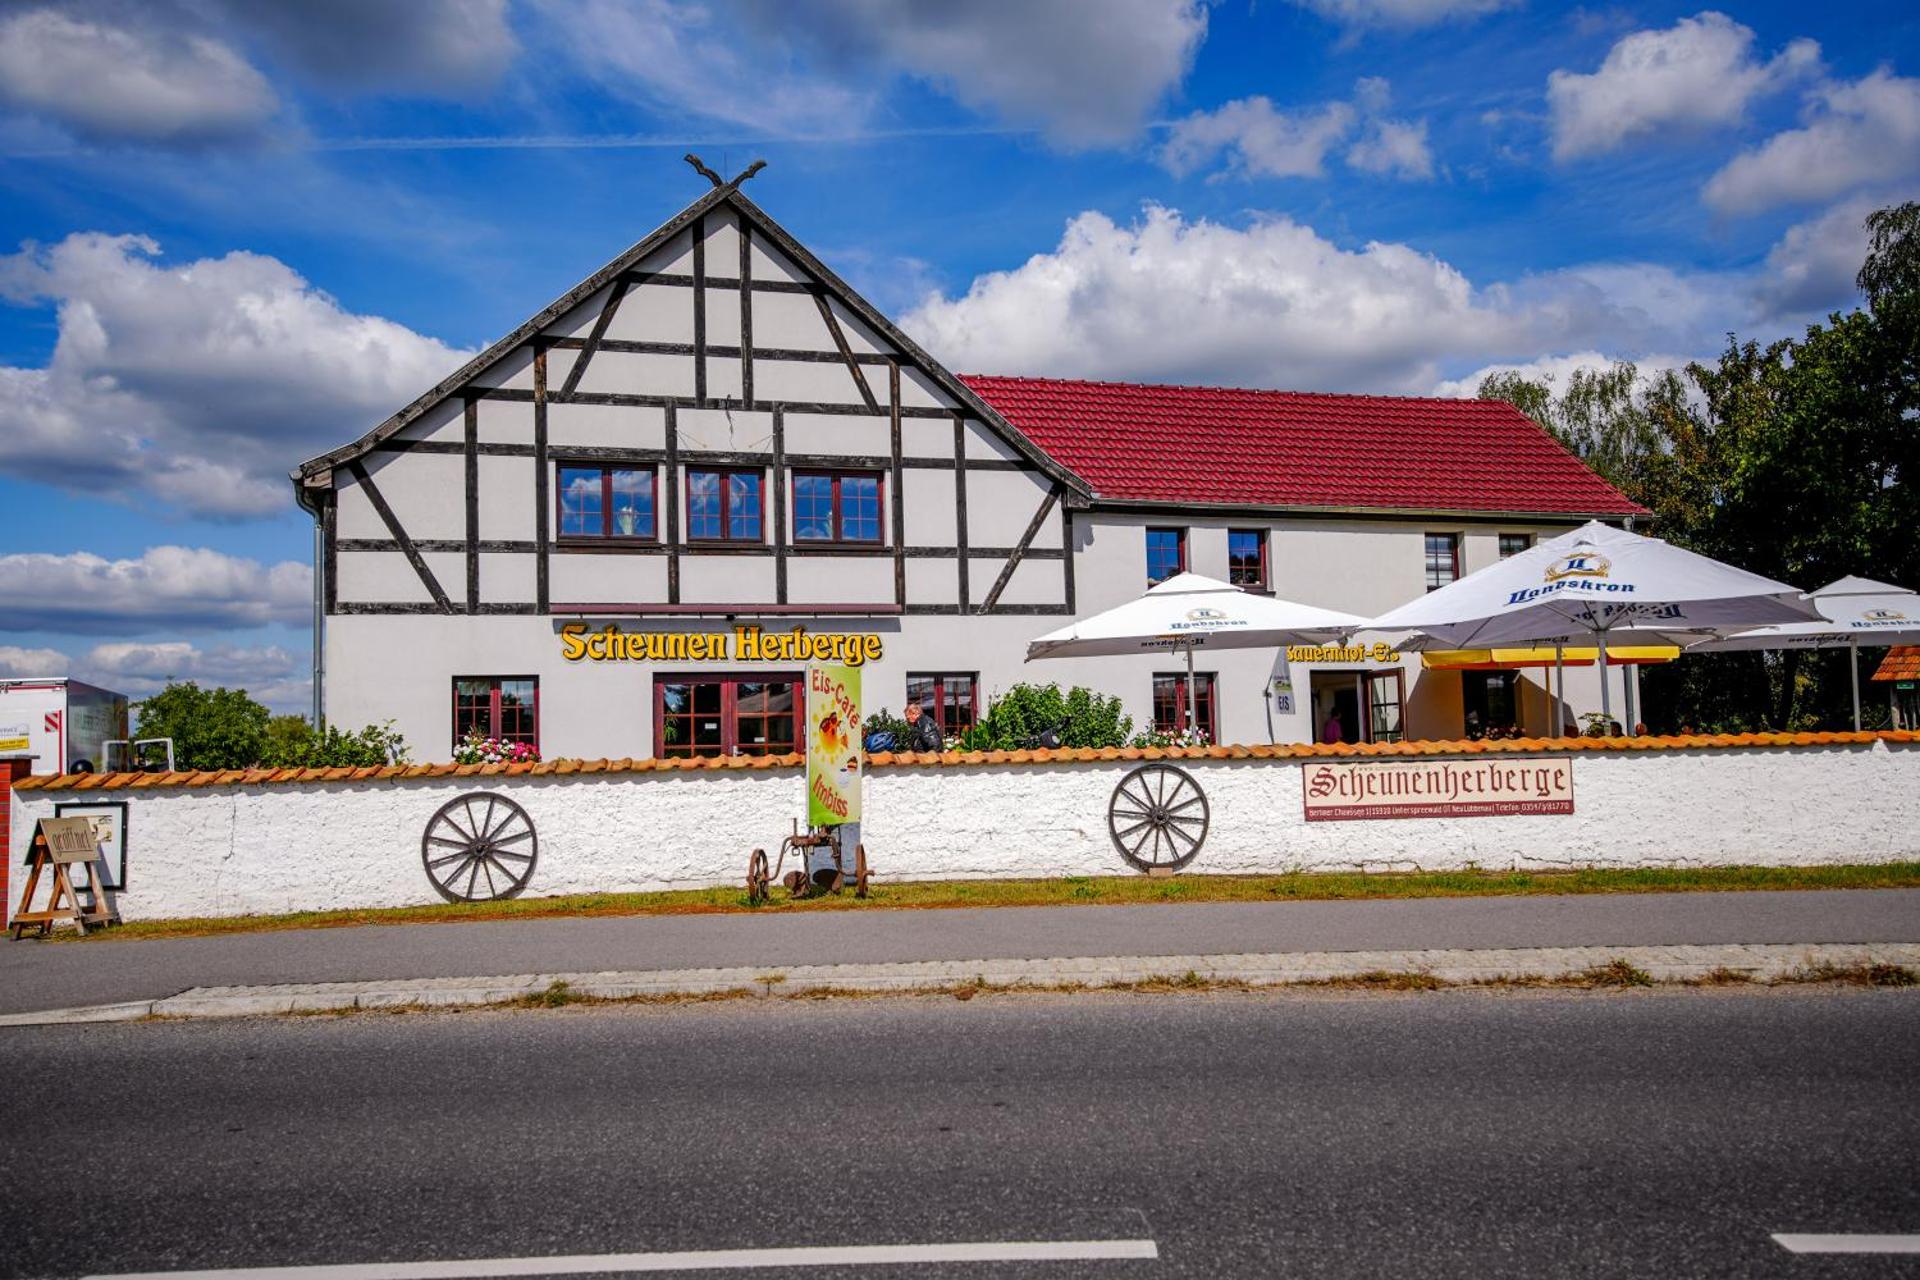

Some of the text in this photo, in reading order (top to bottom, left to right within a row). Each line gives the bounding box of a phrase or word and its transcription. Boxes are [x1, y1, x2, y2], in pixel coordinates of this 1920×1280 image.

[1850, 619, 1920, 627] Landskro
[561, 624, 883, 666] Scheunen Herberge
[812, 668, 861, 729] Eis-Café
[1278, 695, 1290, 711] EIS
[813, 774, 849, 817] Imbiss
[1308, 763, 1567, 801] Scheunenherberge
